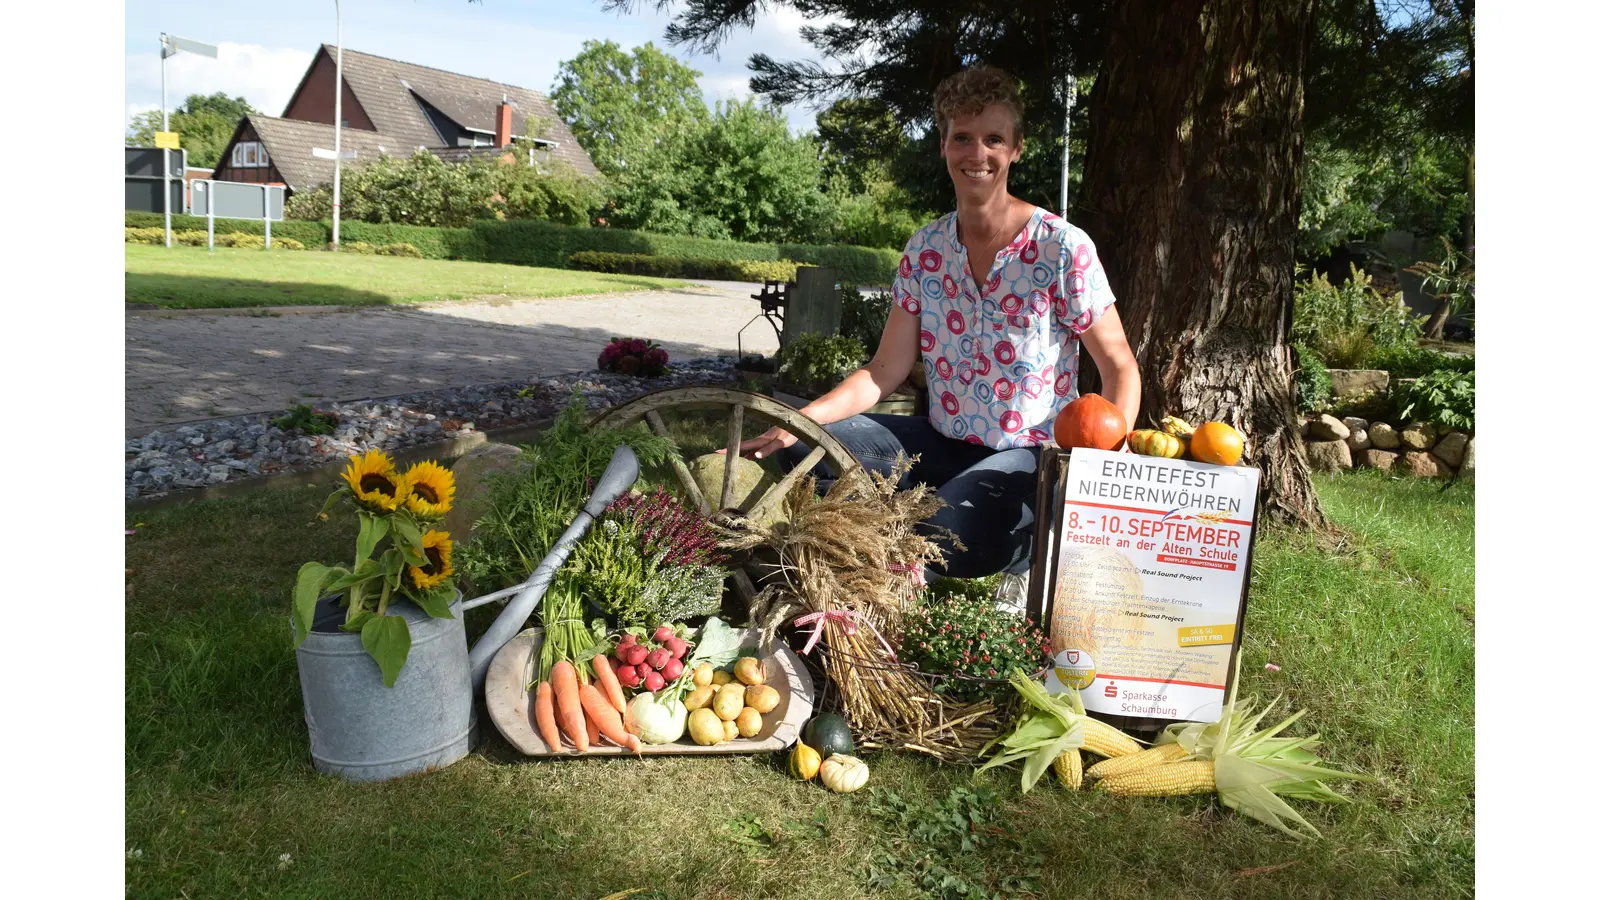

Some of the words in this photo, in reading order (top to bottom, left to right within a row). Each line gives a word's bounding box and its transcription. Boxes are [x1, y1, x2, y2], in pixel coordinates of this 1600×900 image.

[1102, 460, 1220, 489] ERNTEFEST
[1079, 480, 1241, 513] NIEDERNWÖHREN
[1127, 518, 1241, 549] SEPTEMBER
[1066, 531, 1111, 546] Festzelt
[1116, 539, 1130, 549] an
[1136, 539, 1157, 553] der
[1161, 542, 1193, 556] Alten
[1199, 546, 1238, 562] Schule
[1141, 568, 1157, 576] Real
[1157, 570, 1179, 579] Sound
[1179, 573, 1203, 582] Project
[1141, 594, 1160, 603] Einzug
[1171, 598, 1203, 608] Erntekrone
[1124, 610, 1139, 618] Real
[1139, 612, 1161, 620] Sound
[1160, 614, 1185, 623] Project
[1181, 635, 1208, 643] EINTRITT
[1122, 690, 1168, 703] Sparkasse
[1120, 702, 1177, 718] Schaumburg
